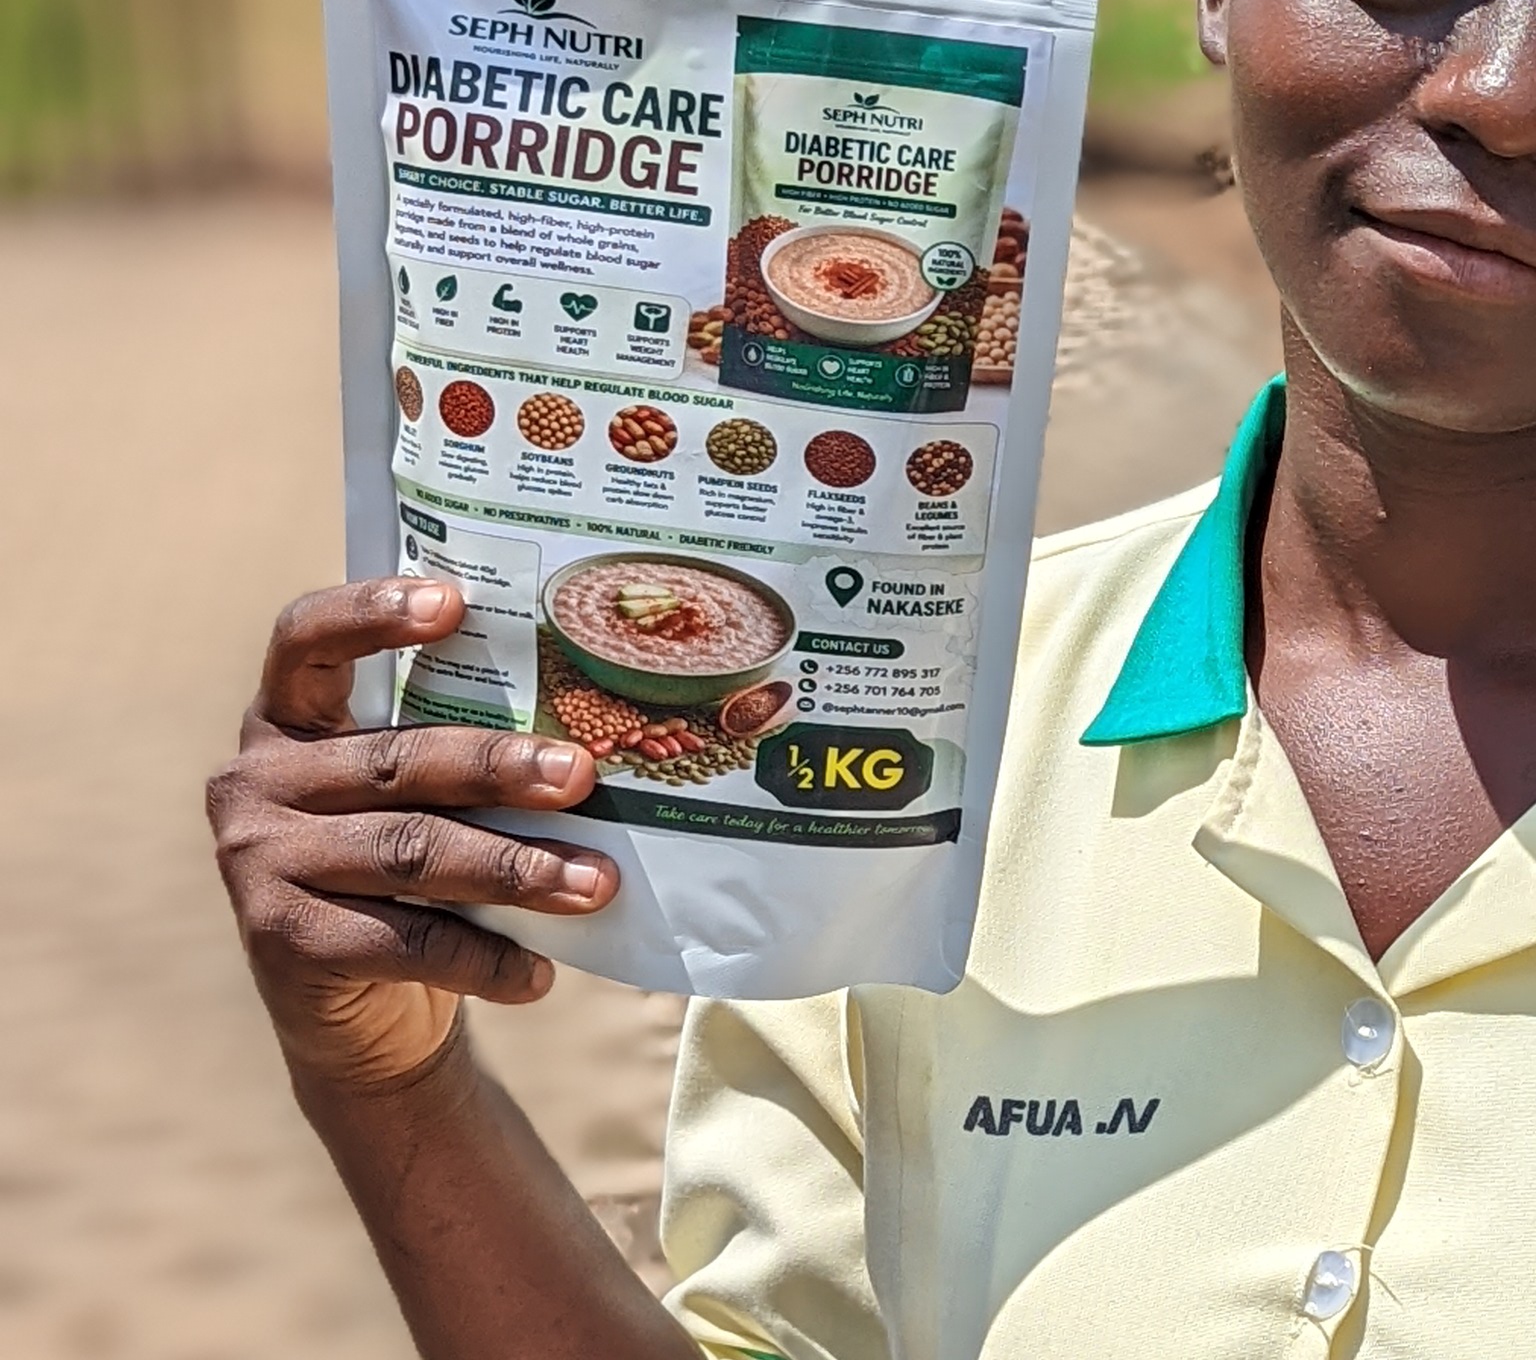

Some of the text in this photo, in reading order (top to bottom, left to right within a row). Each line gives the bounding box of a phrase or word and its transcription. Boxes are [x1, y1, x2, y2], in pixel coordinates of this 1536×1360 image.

[449, 14, 643, 60] SEPH NUTRI
[389, 51, 724, 137] DIABETIC CARE
[822, 107, 867, 125] SEPH
[871, 113, 923, 132] NUTRI
[395, 102, 703, 196] PORRIDGE
[785, 131, 957, 172] DIABETIC CARE
[797, 158, 939, 197] PORRIDGE
[428, 174, 704, 222] CHOICE. STABLE SUGAR. BETTER LIFE.
[405, 351, 734, 411] POWERFUL INGREDIENTS THAT HELP REGULATE BLOOD SUGAR
[521, 451, 574, 467] SOYBEANS
[605, 463, 676, 481] GROUNDNUTS
[698, 474, 778, 495] PUMPKIN SEEDS
[807, 489, 866, 505] FLAXSEEDS
[483, 506, 775, 556] NO PRESERVATIVES 100% NATURAL DIABETIC FRIENDLY
[871, 580, 945, 597] FOUND IN
[866, 597, 966, 617] NAKASEKE
[811, 638, 890, 655] CONTACT US
[825, 664, 942, 679] +256 772 895 317
[824, 682, 941, 697] +256 701 764 705
[824, 745, 905, 790] KG
[655, 804, 687, 821] Take
[688, 813, 720, 826] care
[723, 812, 763, 835] today
[766, 818, 790, 836] for
[793, 823, 803, 835] a
[806, 822, 872, 837] healthier
[963, 1095, 1082, 1136] AFUA
